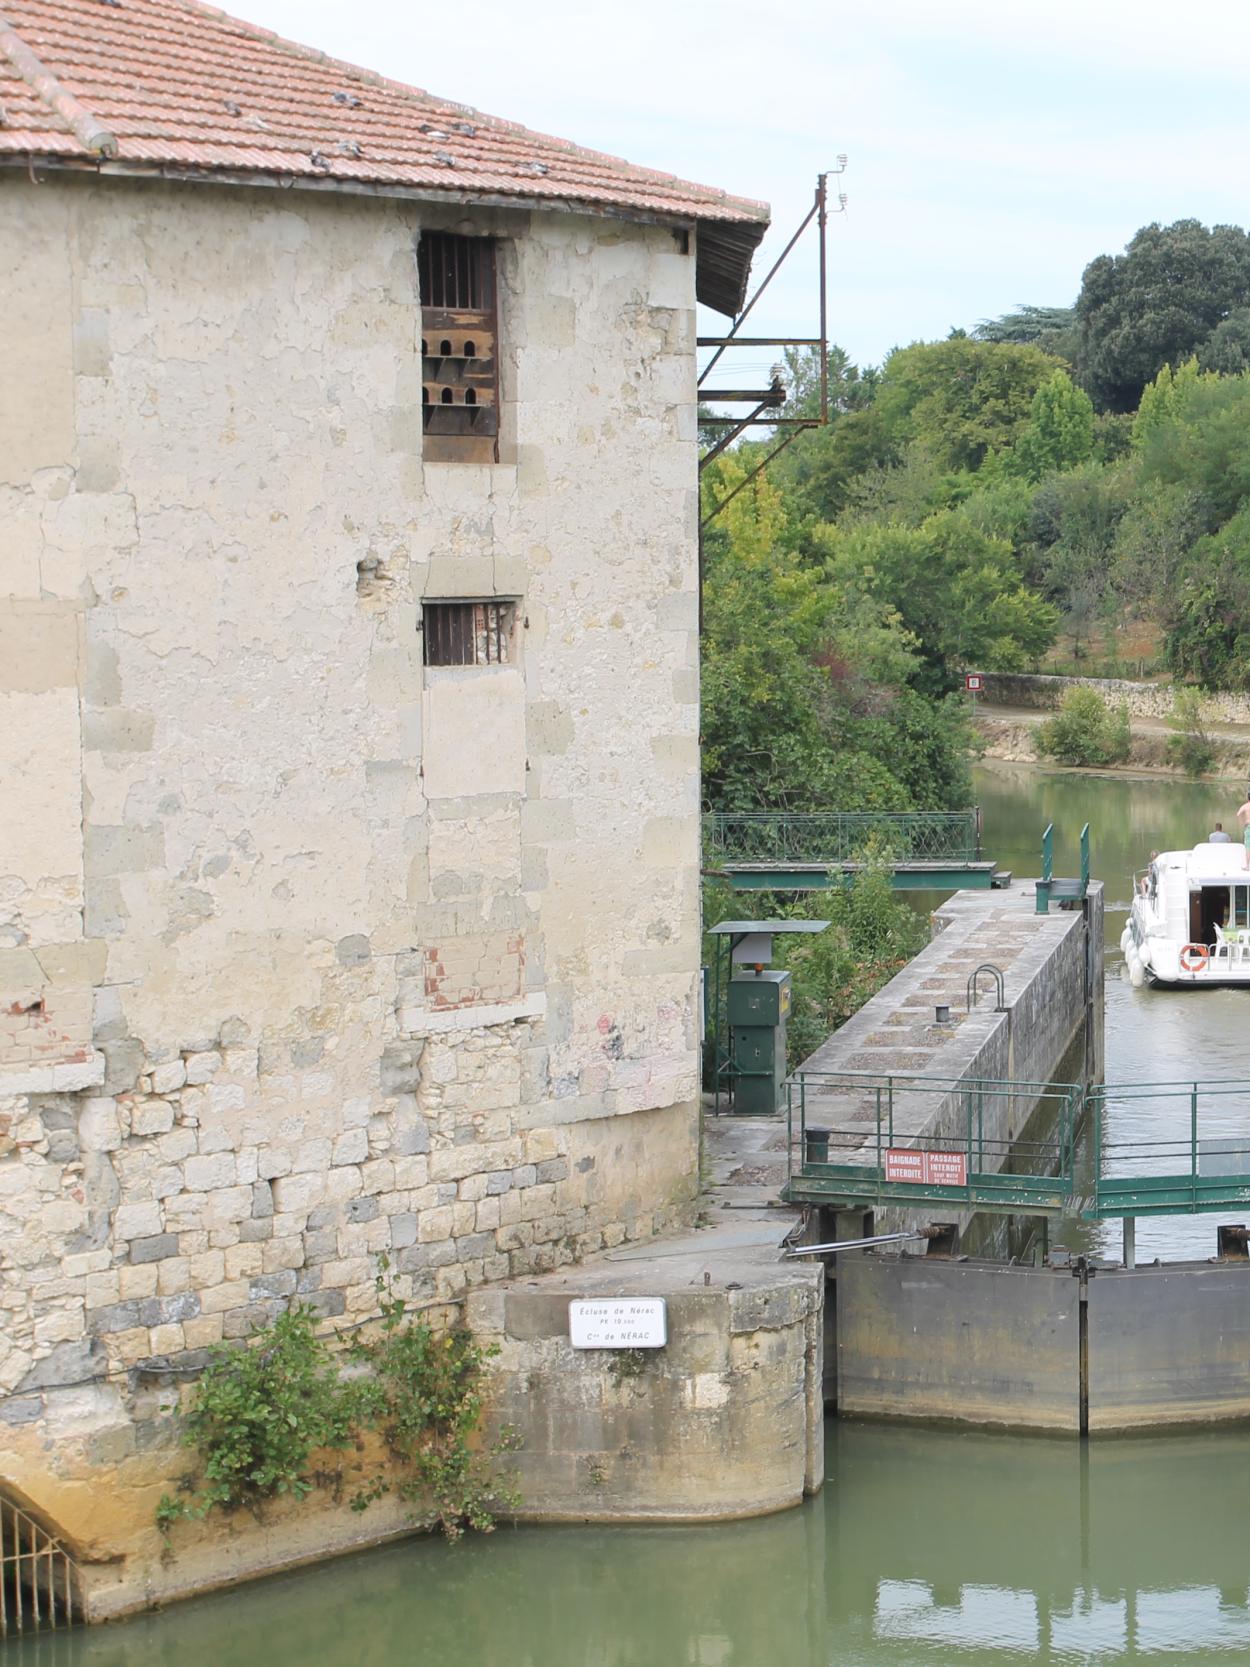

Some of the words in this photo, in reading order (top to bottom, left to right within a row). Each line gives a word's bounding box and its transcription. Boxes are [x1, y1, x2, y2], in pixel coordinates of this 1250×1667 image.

[889, 1155, 921, 1166] BAIGNADE
[929, 1154, 961, 1163] PASSAGE
[930, 1163, 962, 1172] INTERDIT
[889, 1168, 922, 1179] INTERDITE
[579, 1307, 608, 1316] Écluse
[630, 1307, 656, 1315] Nérac
[620, 1332, 650, 1340] NÉRAC
